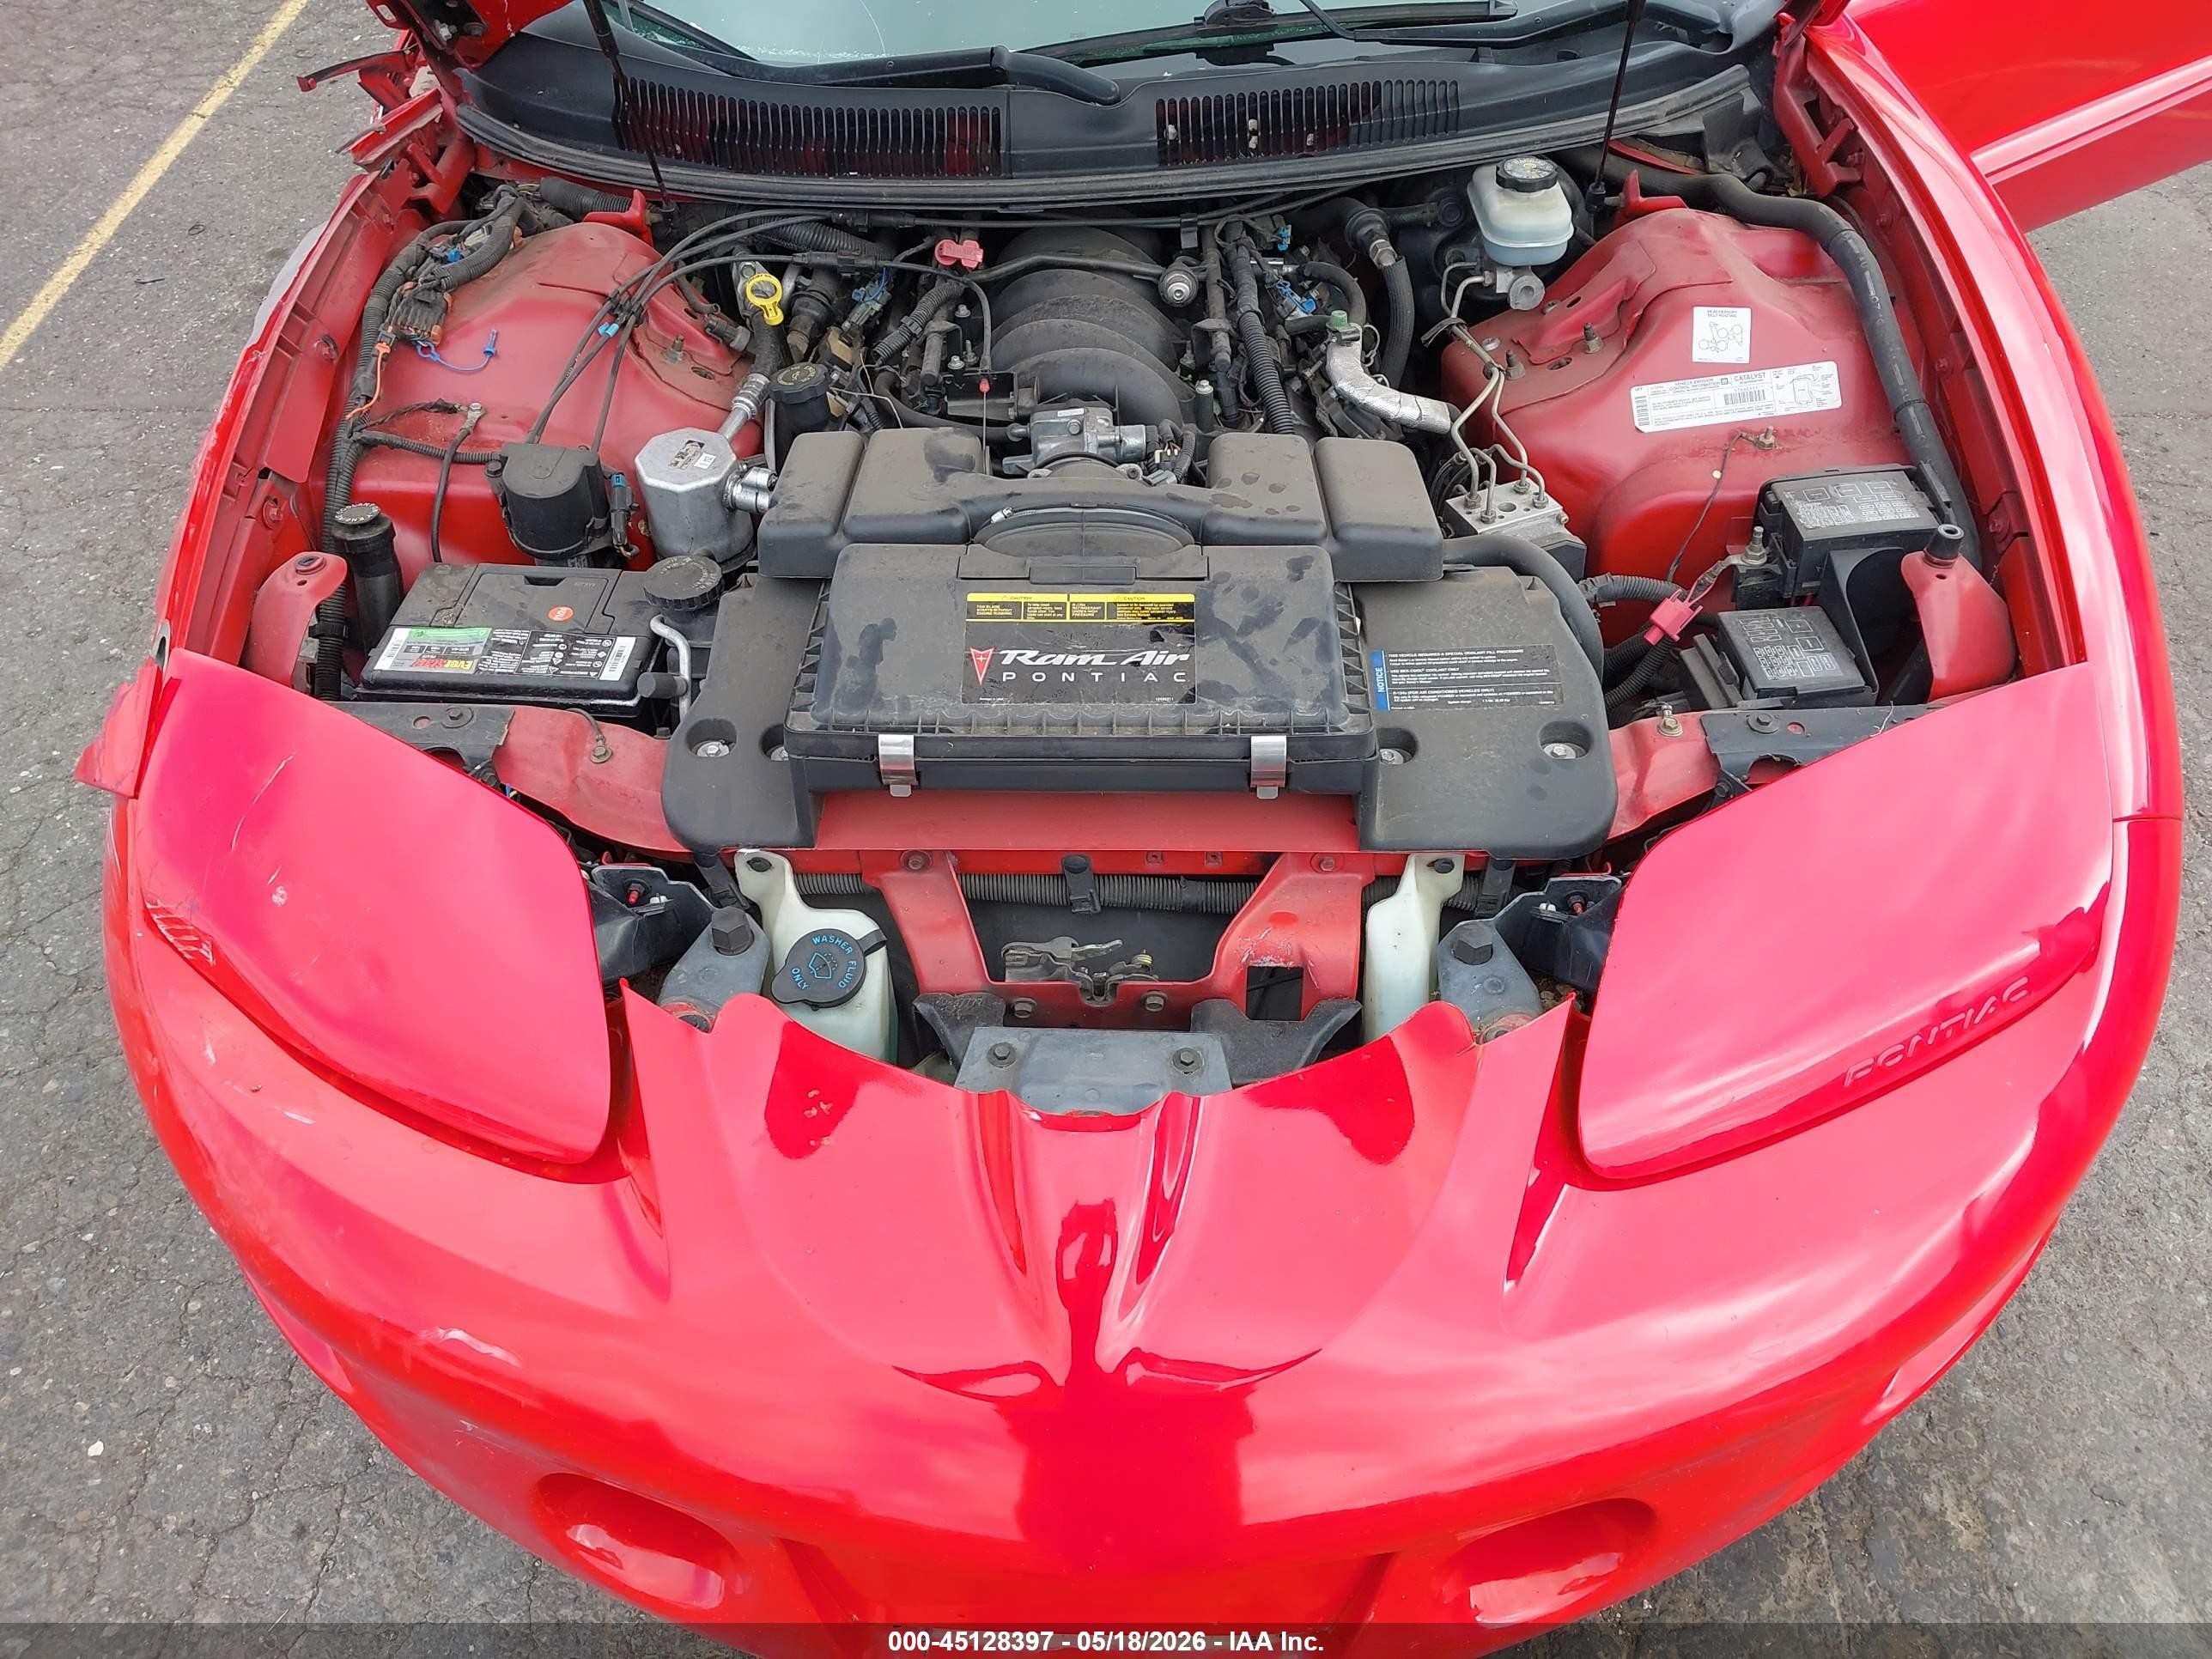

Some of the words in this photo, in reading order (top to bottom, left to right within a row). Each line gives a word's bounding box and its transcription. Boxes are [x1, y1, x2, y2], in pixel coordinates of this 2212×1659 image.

[1734, 372, 1765, 382] CATALYST
[999, 649, 1117, 665] Ram
[1120, 650, 1190, 665] Air
[1002, 672, 1187, 683] PONTIAC
[1375, 667, 1385, 693] NOTICE
[812, 935, 854, 955] WASHER
[792, 968, 810, 989] ONLY
[838, 960, 857, 988] FLUID
[1843, 975, 2030, 1088] PONTIAC
